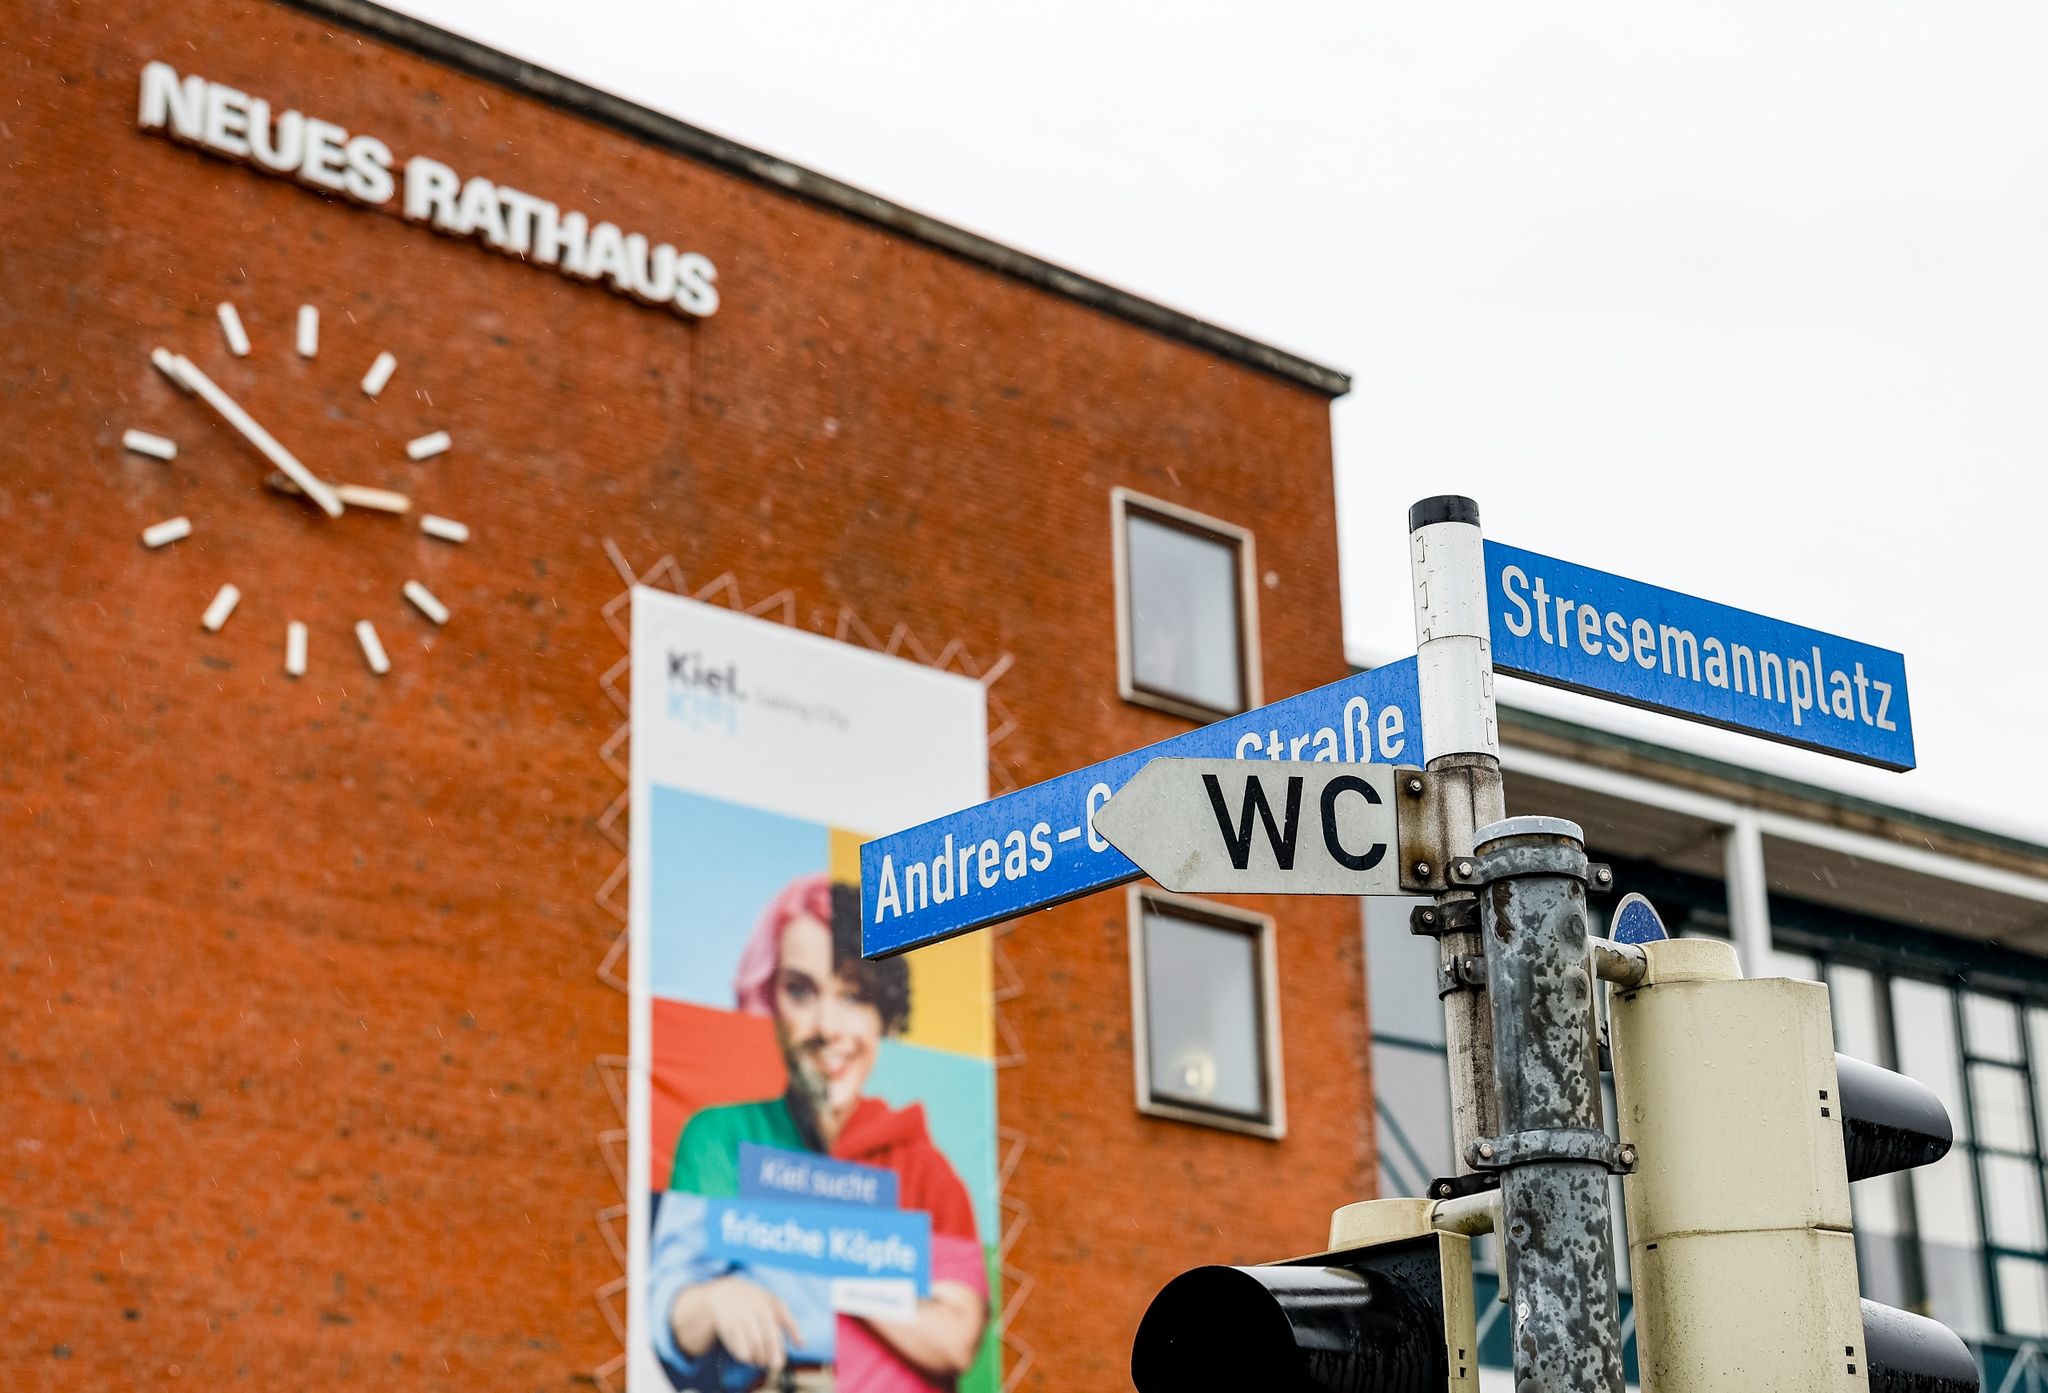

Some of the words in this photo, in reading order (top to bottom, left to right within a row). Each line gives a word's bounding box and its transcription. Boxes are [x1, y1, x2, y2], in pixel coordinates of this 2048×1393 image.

[139, 60, 394, 204] NEUES
[404, 155, 720, 318] RATHAUS
[1500, 564, 1897, 732] Stresemannplatz
[1201, 774, 1388, 872] WC
[760, 1157, 811, 1194] Kiel
[721, 1208, 825, 1258] frische
[828, 1227, 917, 1273] Köpfe
